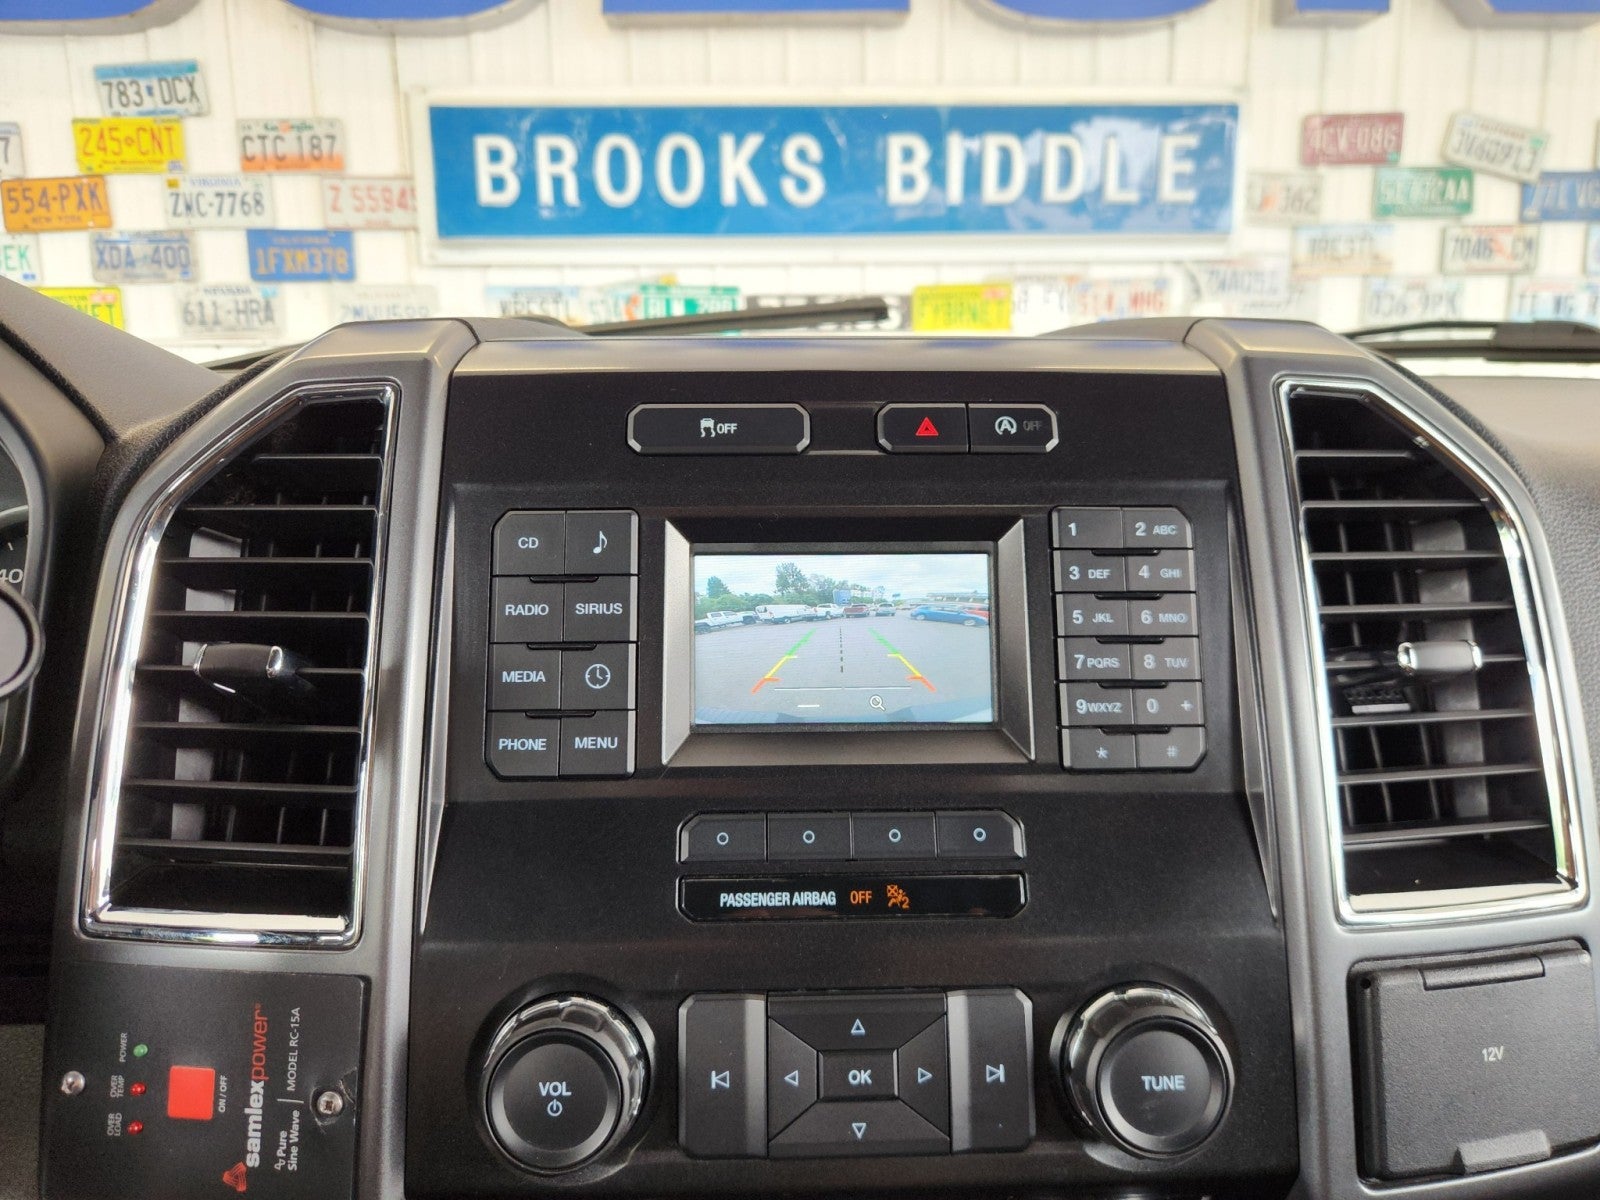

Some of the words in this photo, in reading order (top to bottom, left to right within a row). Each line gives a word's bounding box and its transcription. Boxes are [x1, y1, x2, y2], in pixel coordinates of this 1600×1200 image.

[102, 79, 144, 109] 783
[158, 75, 200, 106] DCX
[473, 132, 826, 209] BROOKS
[885, 130, 1200, 207] BIDDLE
[717, 423, 738, 435] OFF
[1068, 522, 1078, 537] 1
[1135, 521, 1147, 537] 2
[1152, 524, 1178, 535] ABC
[518, 537, 539, 549] CD
[1068, 565, 1081, 580] 3
[1087, 568, 1111, 579] DEF
[1138, 565, 1150, 579] 4
[1159, 568, 1182, 579] GHI
[505, 604, 549, 616] RADIO
[575, 603, 623, 615] SIRIUS
[1072, 609, 1084, 624] 5
[1092, 613, 1115, 623] JKL
[1140, 609, 1153, 624] 6
[1158, 613, 1188, 623] MNO
[1074, 654, 1086, 669] 7
[1087, 657, 1121, 669] PQRS
[1143, 654, 1157, 669] 8
[1164, 657, 1189, 668] TUV
[502, 671, 546, 683] MEDIA
[1076, 699, 1087, 714] 9
[1087, 702, 1123, 713] WXYZ
[1146, 698, 1159, 713] 0
[499, 738, 547, 750] PHONE
[574, 737, 618, 749] MENU
[720, 892, 790, 907] PASSENGER
[792, 891, 836, 905] AIRBAG
[850, 890, 872, 904] OFF
[289, 1007, 300, 1047] RC-15A
[119, 1032, 128, 1063] POWER
[1481, 1046, 1504, 1062] 12V
[286, 1049, 298, 1092] MODEL
[848, 1070, 873, 1085] OK
[110, 1075, 118, 1098] OVER
[117, 1075, 125, 1098] TEMP
[220, 1075, 228, 1092] OFF
[539, 1081, 571, 1097] VOL
[1141, 1075, 1185, 1091] TUNE
[218, 1099, 226, 1113] ON
[107, 1113, 115, 1136] OVER
[114, 1113, 123, 1136] LOAD
[289, 1109, 300, 1144] Wave
[277, 1130, 288, 1157] Pure
[287, 1146, 298, 1171] Sine
